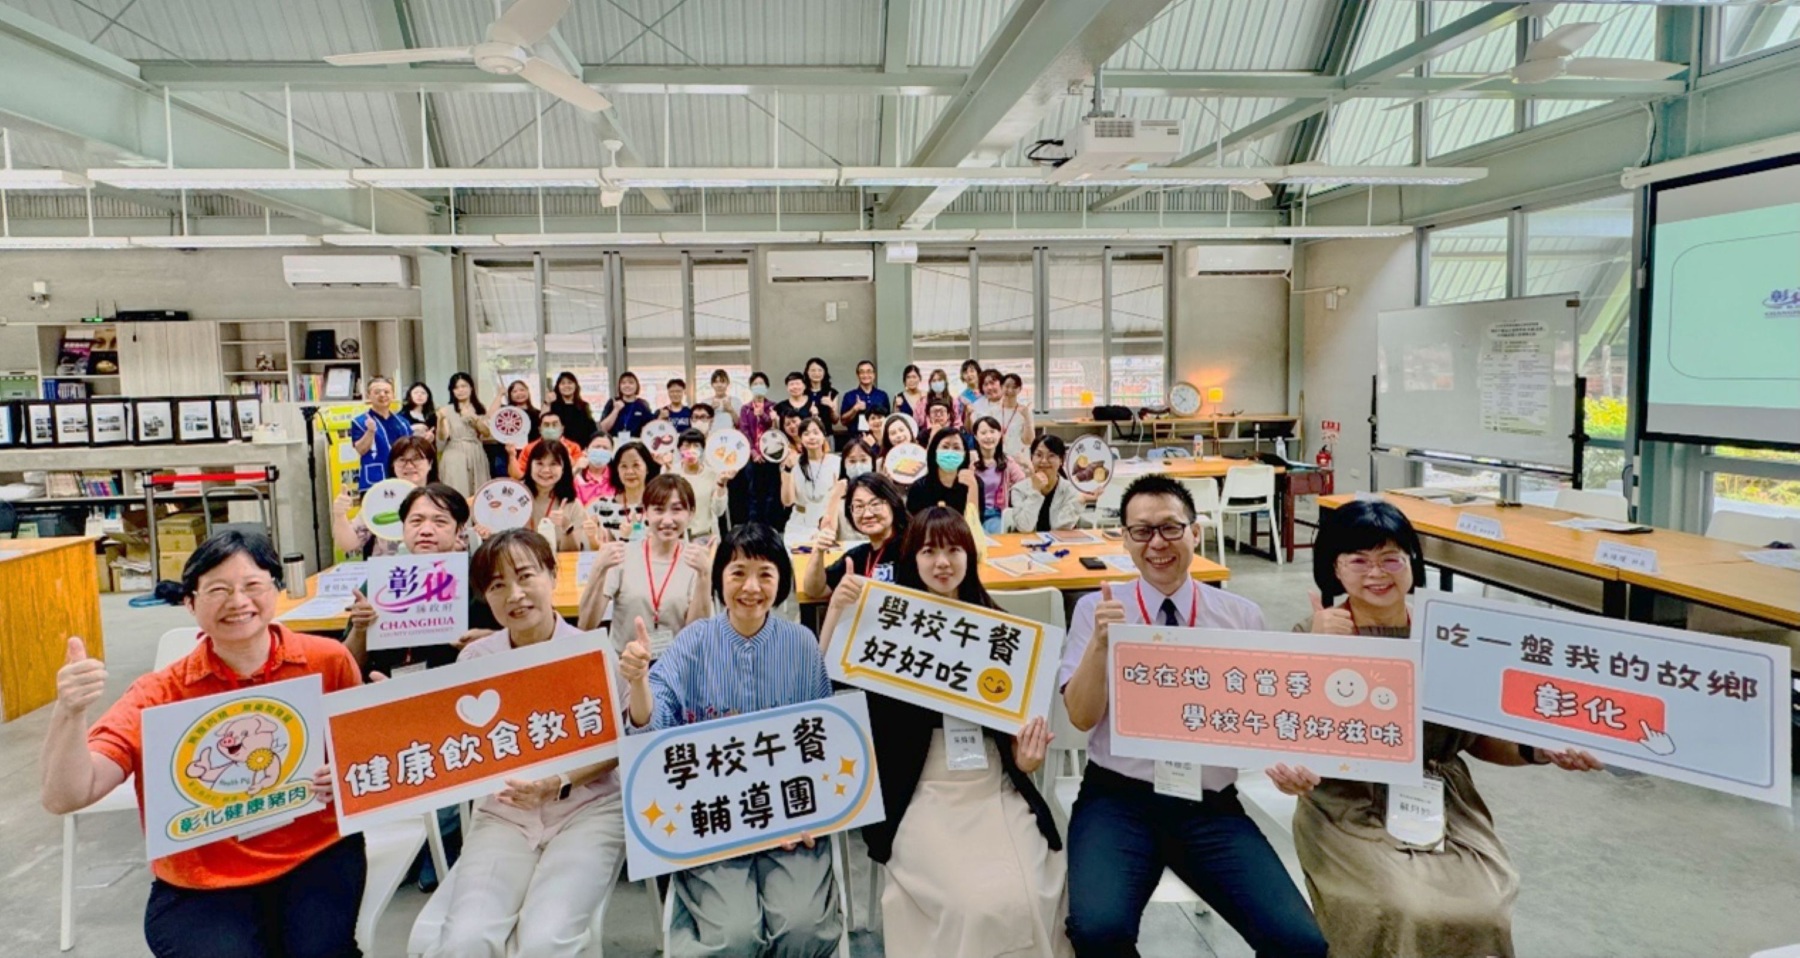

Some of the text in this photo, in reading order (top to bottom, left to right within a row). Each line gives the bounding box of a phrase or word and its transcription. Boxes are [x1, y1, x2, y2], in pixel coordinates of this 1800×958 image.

[388, 560, 459, 602] 彰化
[380, 616, 454, 630] CHANGHUA
[878, 595, 1021, 666] 學校午餐
[859, 635, 972, 692] 好好吃
[1123, 662, 1312, 698] 吃在地 食當季
[1436, 623, 1758, 702] 吃一盤我的故鄉
[1181, 703, 1403, 747] 學校午餐好滋味
[1534, 682, 1627, 730] 彰化
[344, 696, 604, 798] 健康飲食教育
[663, 716, 827, 790] 學校午餐
[180, 786, 306, 832] 彰化健康豬肉
[691, 776, 817, 838] 輔導團
